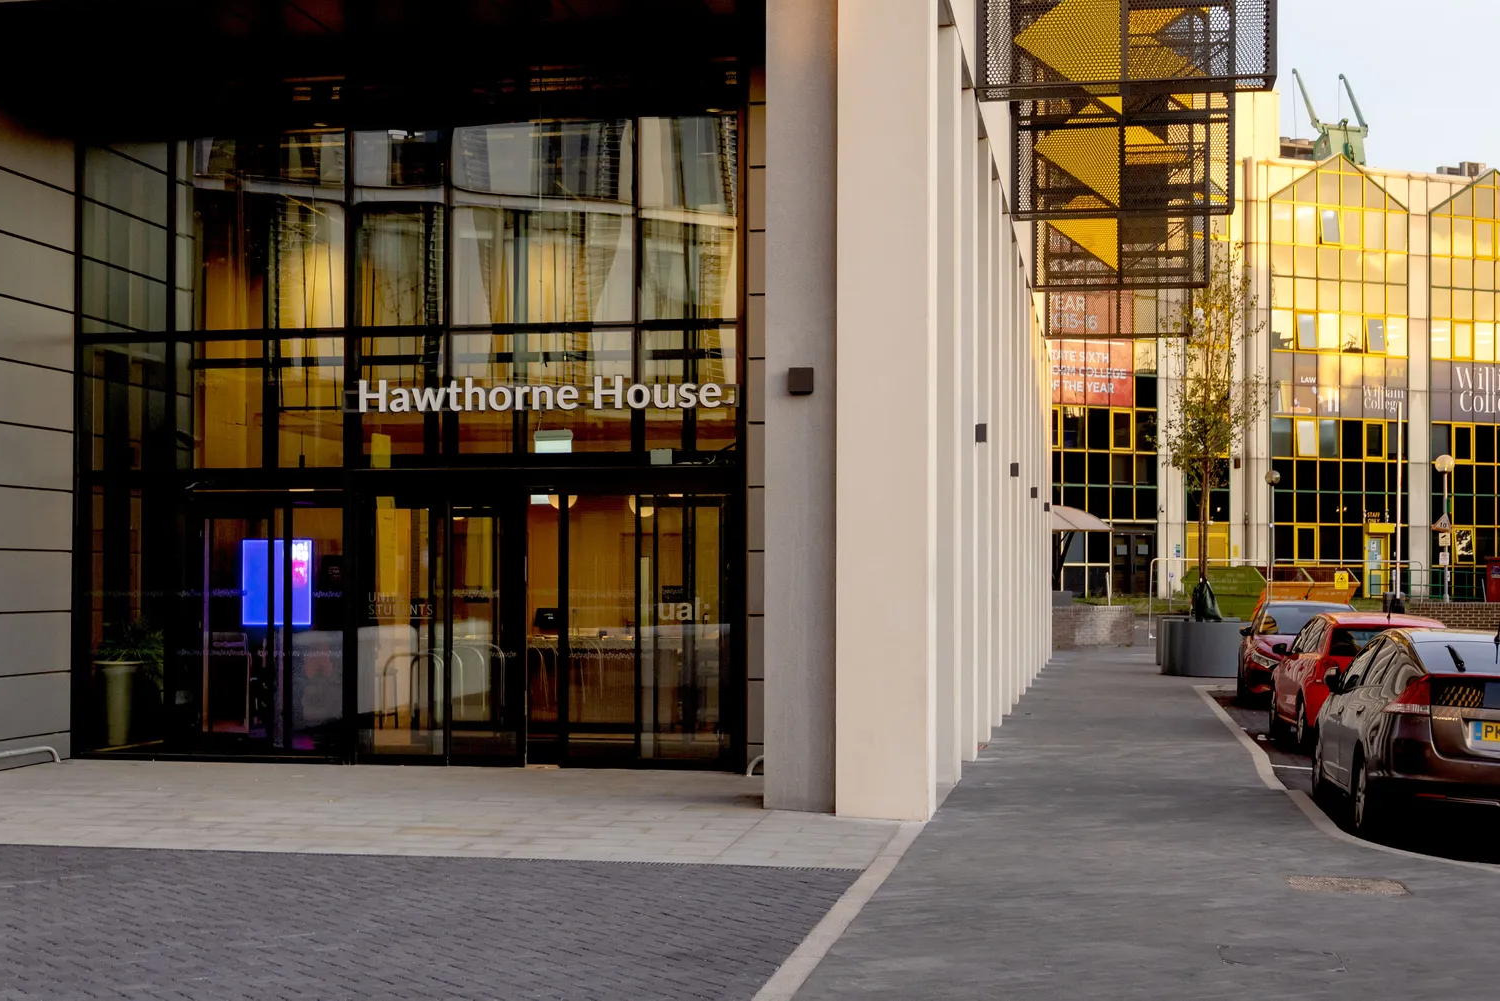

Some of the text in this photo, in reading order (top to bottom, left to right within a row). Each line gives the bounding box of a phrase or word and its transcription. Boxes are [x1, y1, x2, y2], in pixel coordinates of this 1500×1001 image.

[1052, 312, 1098, 330] 015-16
[1052, 350, 1077, 362] TATE
[1052, 365, 1127, 380] ORM COLLEGE
[1300, 376, 1316, 384] LAW
[358, 373, 723, 413] Hawthorne House
[1062, 380, 1084, 392] THE
[1086, 381, 1115, 393] YEAR
[1362, 385, 1404, 399] William
[1364, 396, 1398, 413] Colleg
[1460, 390, 1500, 413] Coll
[658, 597, 710, 621] ual:
